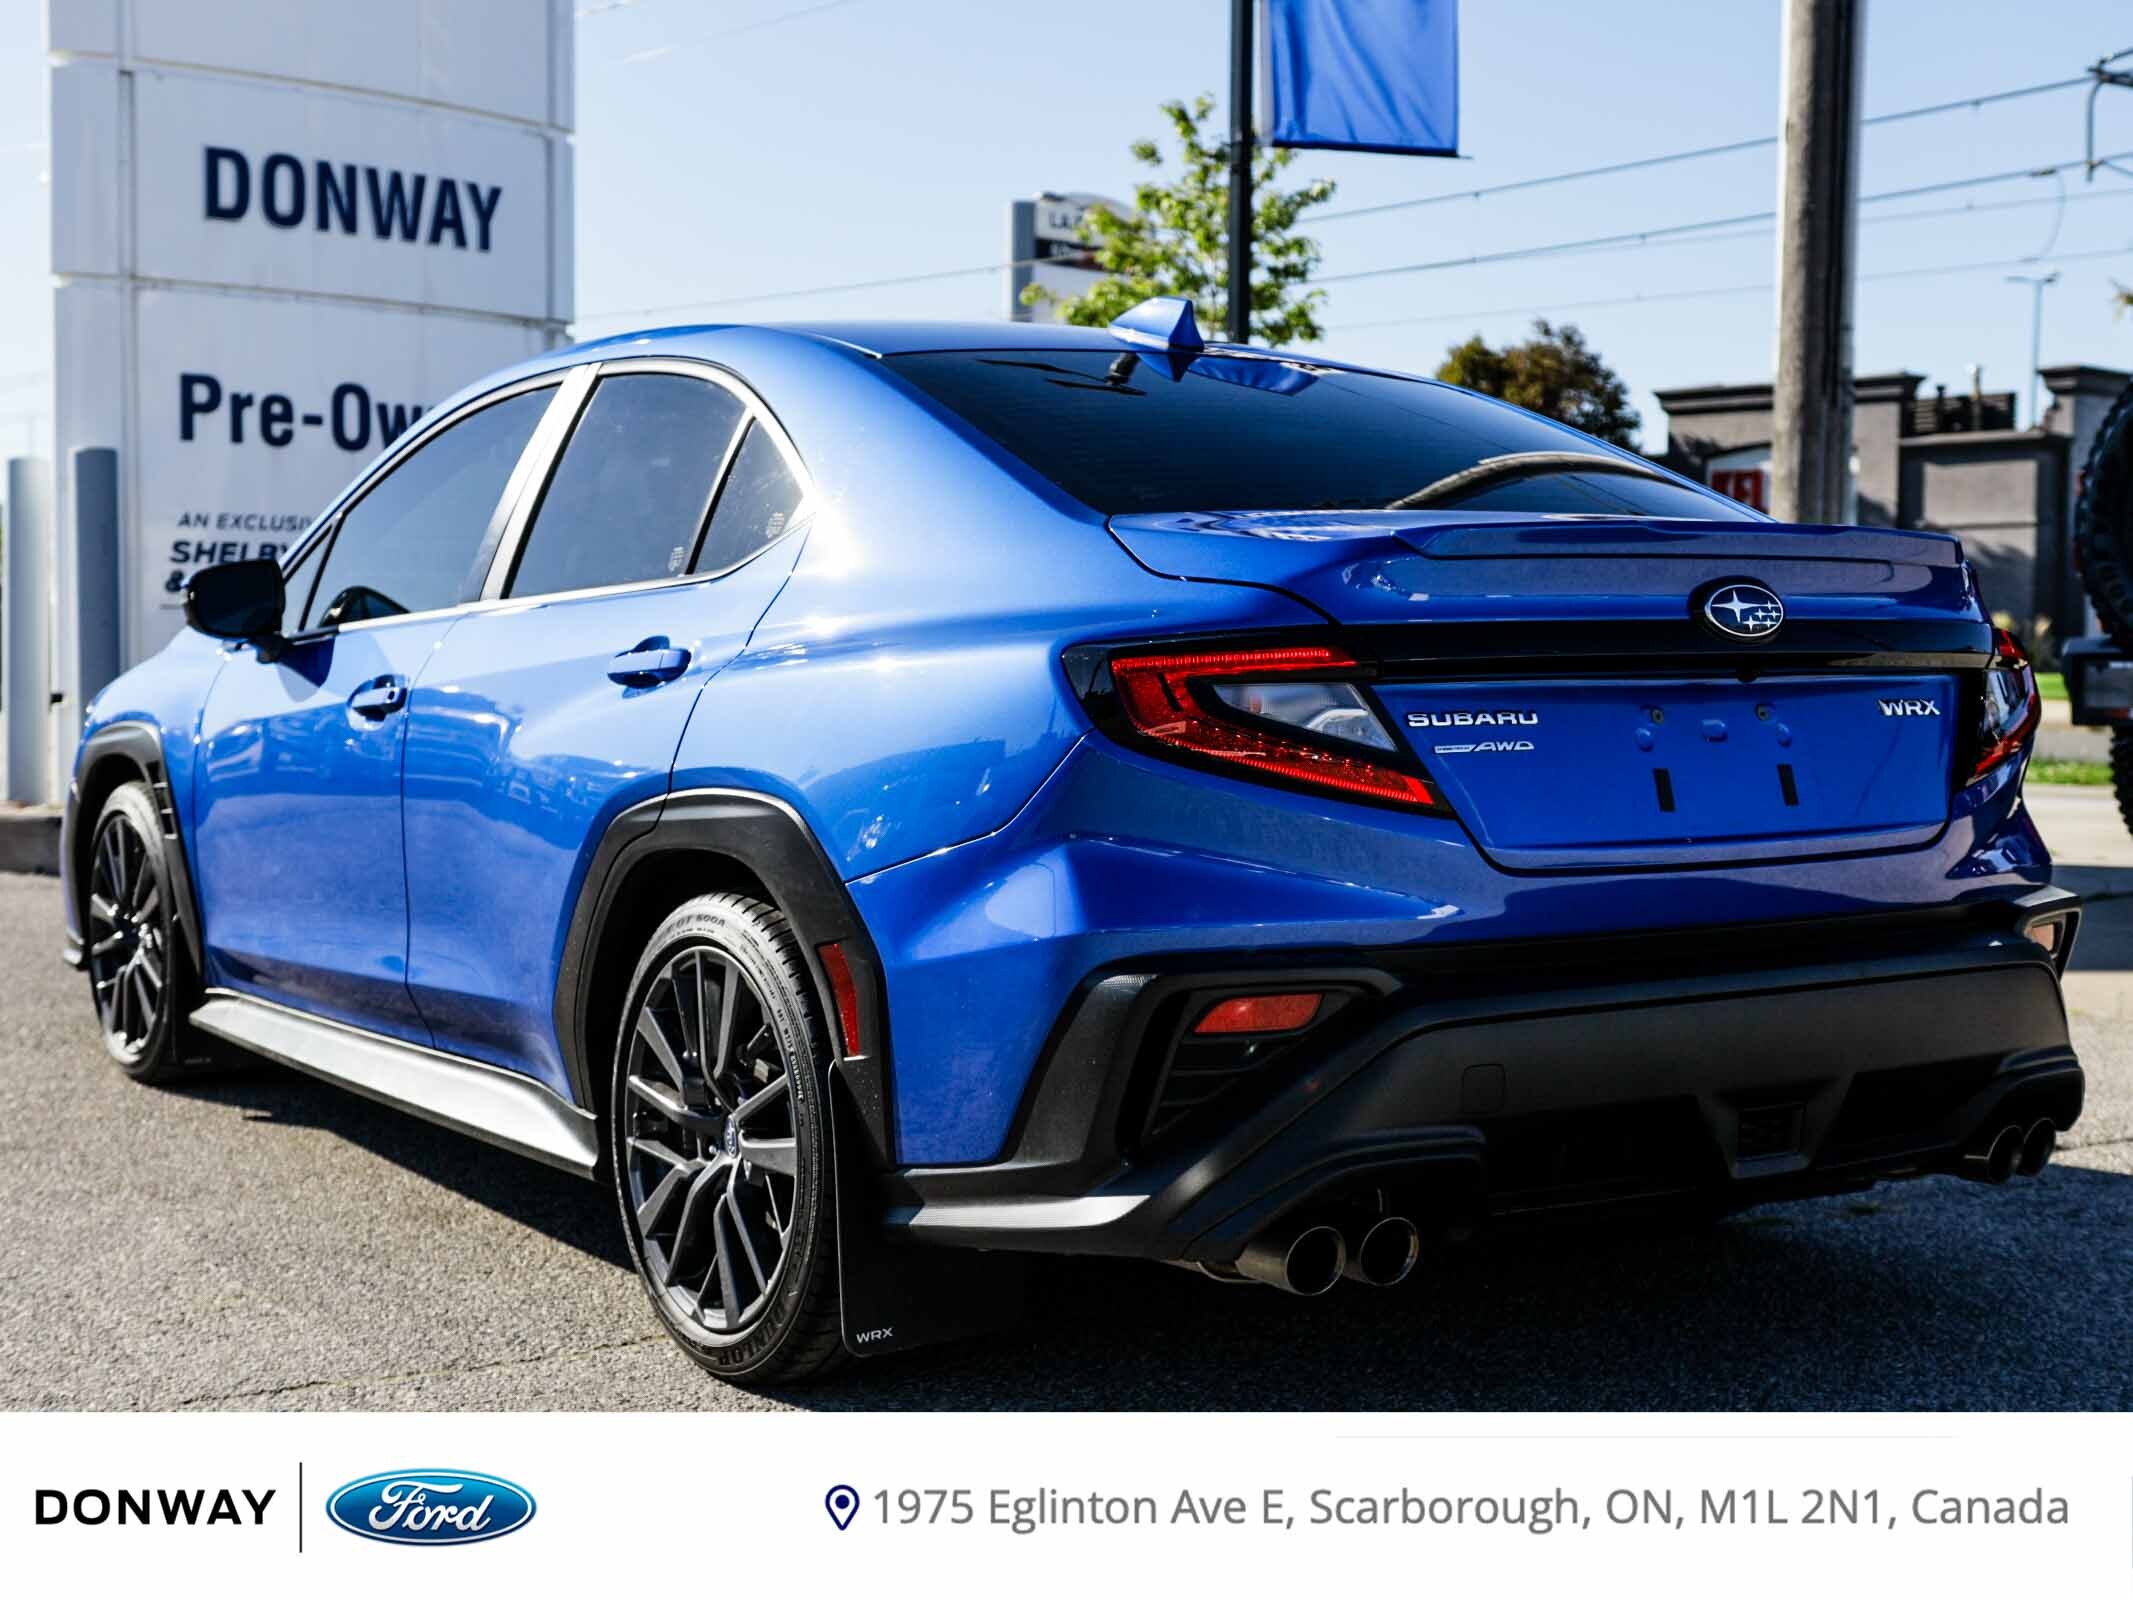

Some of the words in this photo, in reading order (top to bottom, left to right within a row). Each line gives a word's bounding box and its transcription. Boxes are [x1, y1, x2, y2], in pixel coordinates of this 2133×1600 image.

[203, 145, 502, 254] DONWAY
[178, 372, 436, 453] Pre-Ow
[178, 512, 209, 528] AN
[1879, 699, 1941, 716] WRX
[1407, 712, 1538, 727] SUBARU
[1473, 740, 1535, 752] AWD
[856, 1327, 893, 1344] WRX
